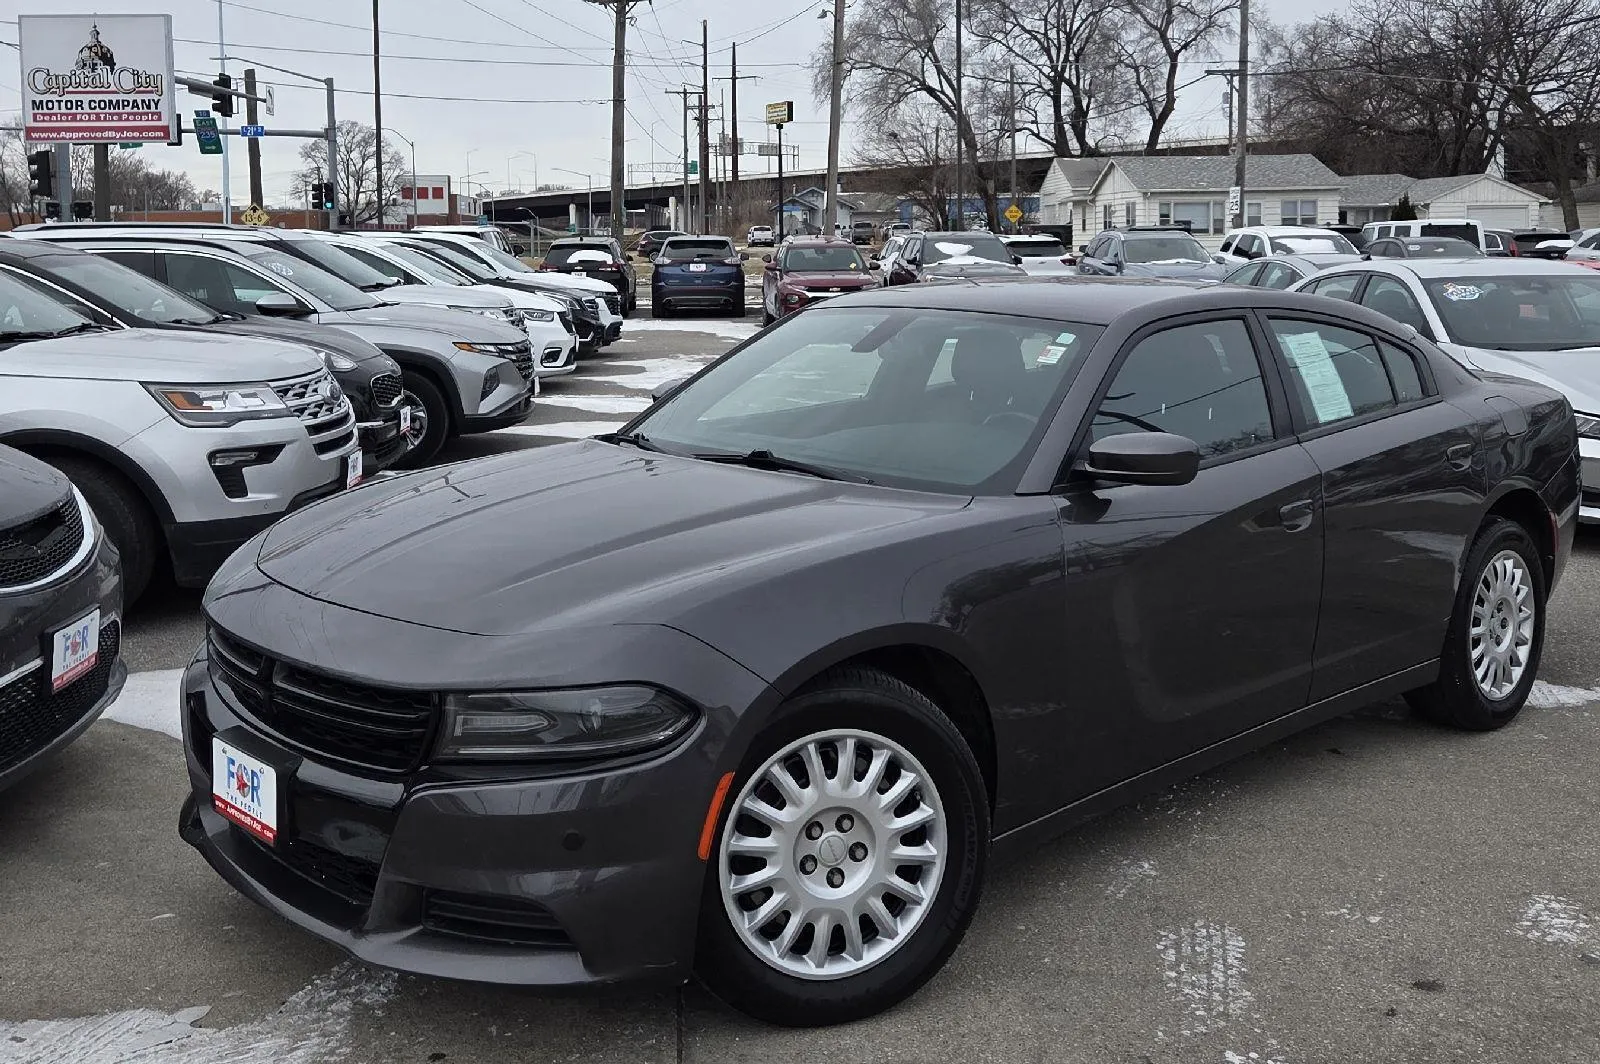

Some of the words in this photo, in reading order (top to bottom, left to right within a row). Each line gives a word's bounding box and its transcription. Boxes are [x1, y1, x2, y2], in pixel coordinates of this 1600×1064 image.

[28, 65, 111, 97] Capital
[113, 66, 163, 96] City
[31, 99, 84, 111] MOTOR
[88, 99, 161, 111] COMPANY
[122, 113, 158, 121] People
[30, 130, 164, 139] www.ApprovedByJoe.com
[200, 131, 216, 139] 235
[1230, 200, 1239, 210] 25
[226, 791, 238, 805] THE
[240, 801, 263, 820] PEOPLE
